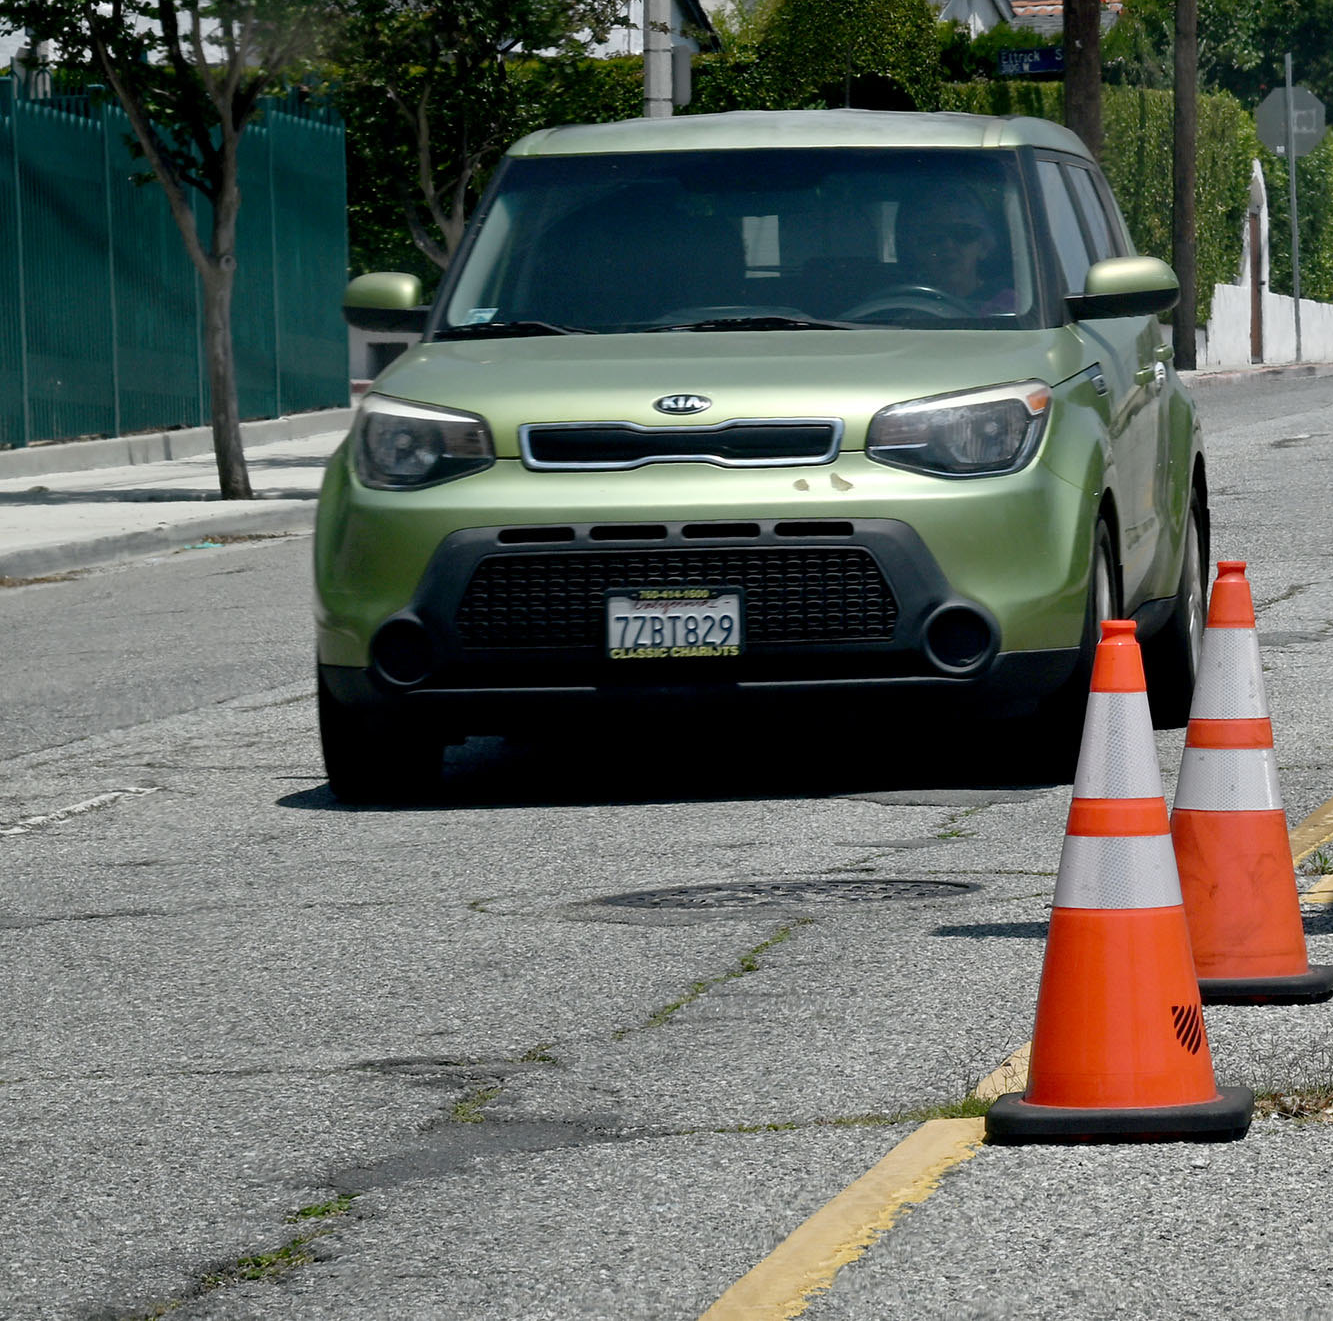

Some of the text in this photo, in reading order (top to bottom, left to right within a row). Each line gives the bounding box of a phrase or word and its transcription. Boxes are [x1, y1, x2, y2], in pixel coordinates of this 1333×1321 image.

[660, 396, 711, 410] KIA
[614, 614, 734, 647] 7ZBT829
[610, 647, 669, 659] CLASSIC
